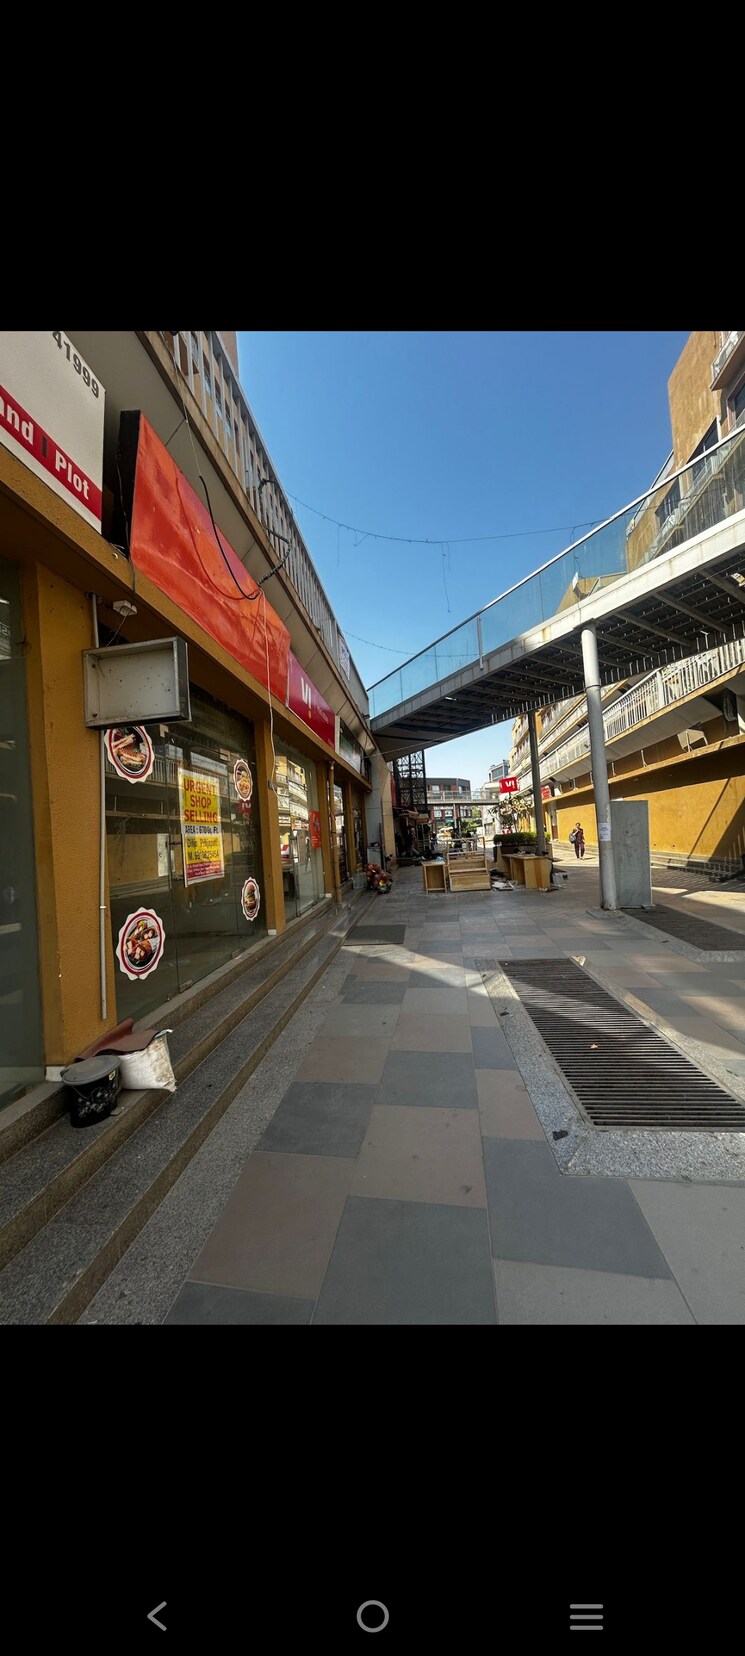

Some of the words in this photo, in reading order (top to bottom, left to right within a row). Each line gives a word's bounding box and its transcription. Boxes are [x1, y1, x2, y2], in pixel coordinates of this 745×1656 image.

[55, 450, 89, 500] Plot
[183, 777, 216, 796] URGENT
[190, 795, 212, 809] SHOP
[184, 809, 218, 823] SELLING
